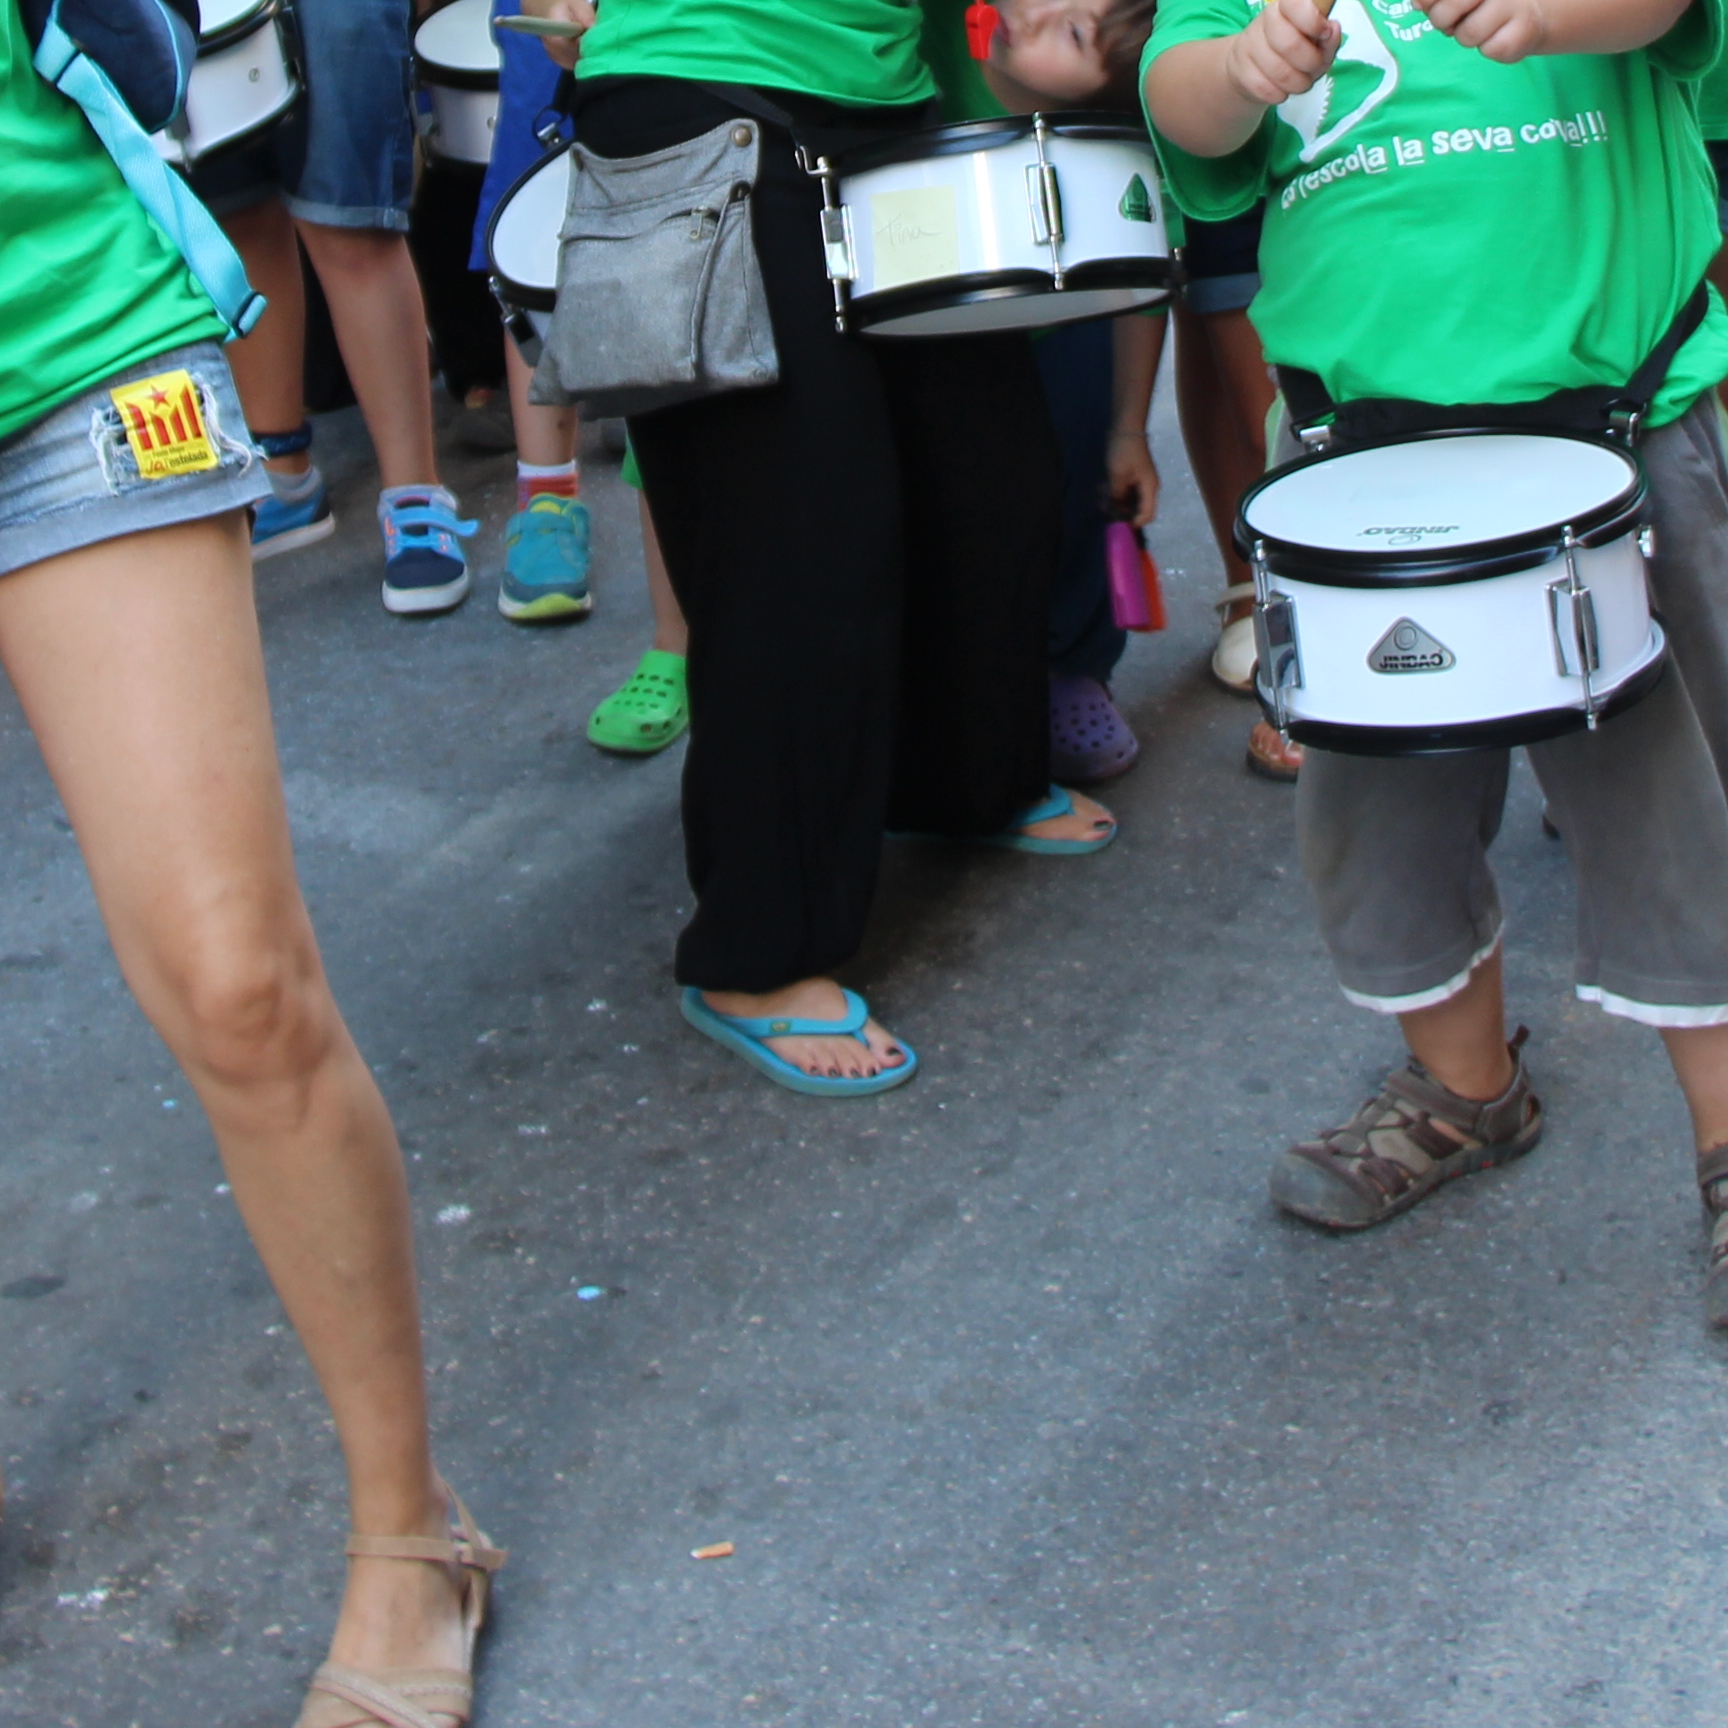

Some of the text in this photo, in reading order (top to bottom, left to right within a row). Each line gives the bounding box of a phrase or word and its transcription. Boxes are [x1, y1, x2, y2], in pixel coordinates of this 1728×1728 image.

[1393, 135, 1425, 166] la
[1430, 124, 1516, 155] seva
[1519, 110, 1609, 148] cova!!!
[1361, 525, 1460, 537] JINDAO
[1379, 653, 1444, 670] JINDAO
